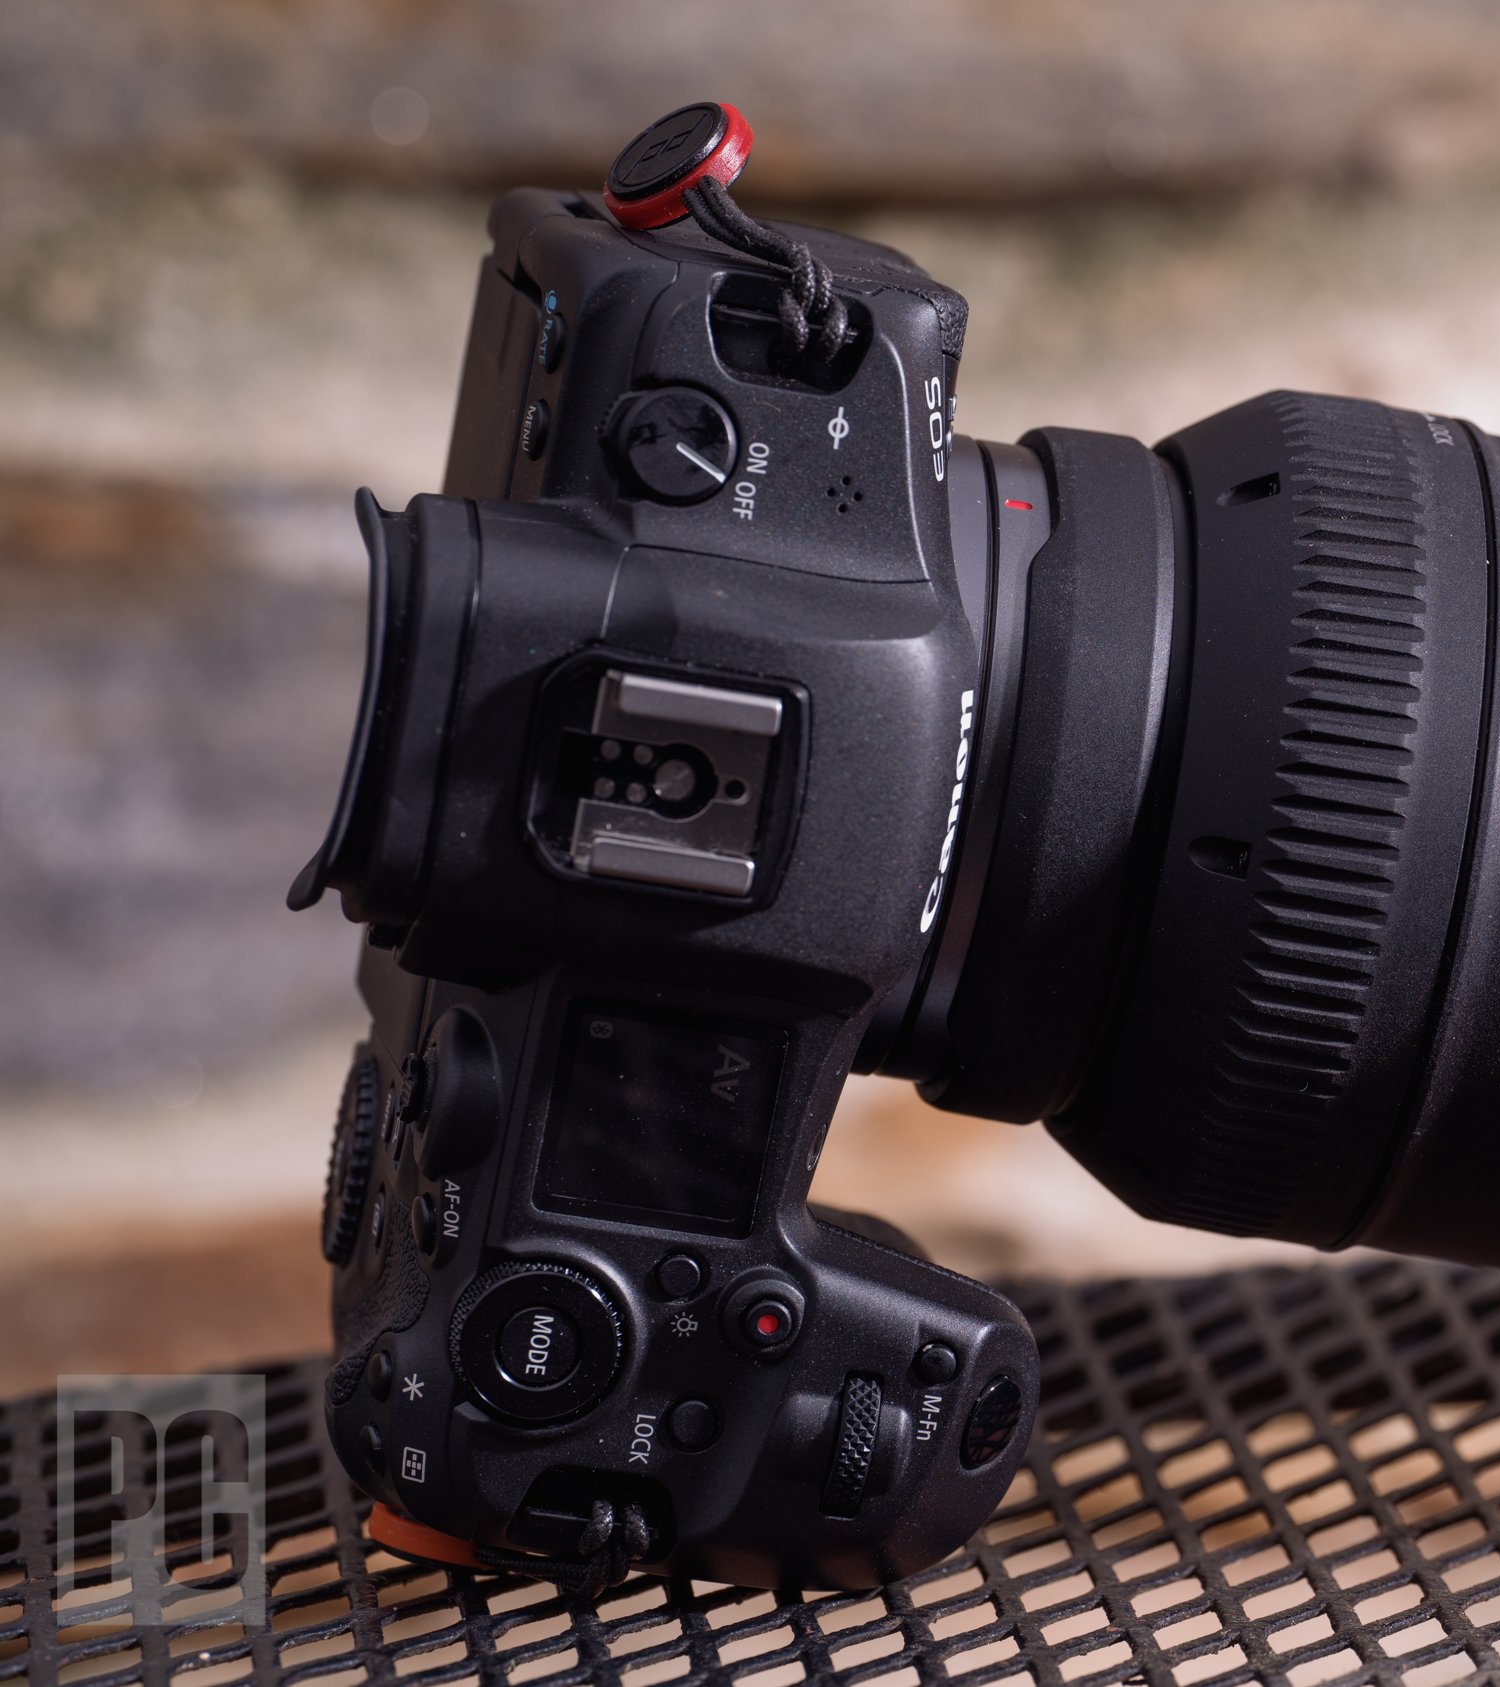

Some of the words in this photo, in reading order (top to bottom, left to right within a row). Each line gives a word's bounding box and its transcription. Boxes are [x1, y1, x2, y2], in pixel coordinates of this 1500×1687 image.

[538, 319, 554, 367] RATE
[521, 405, 538, 452] MENU
[924, 376, 945, 482] EOS
[746, 442, 769, 475] ON
[732, 483, 756, 521] OFF
[919, 689, 974, 933] Canon
[711, 1043, 752, 1103] Av
[442, 1178, 462, 1238] AF-ON
[524, 1314, 555, 1376] MODE
[628, 1412, 658, 1464] LOCK
[915, 1394, 943, 1442] M-Fn
